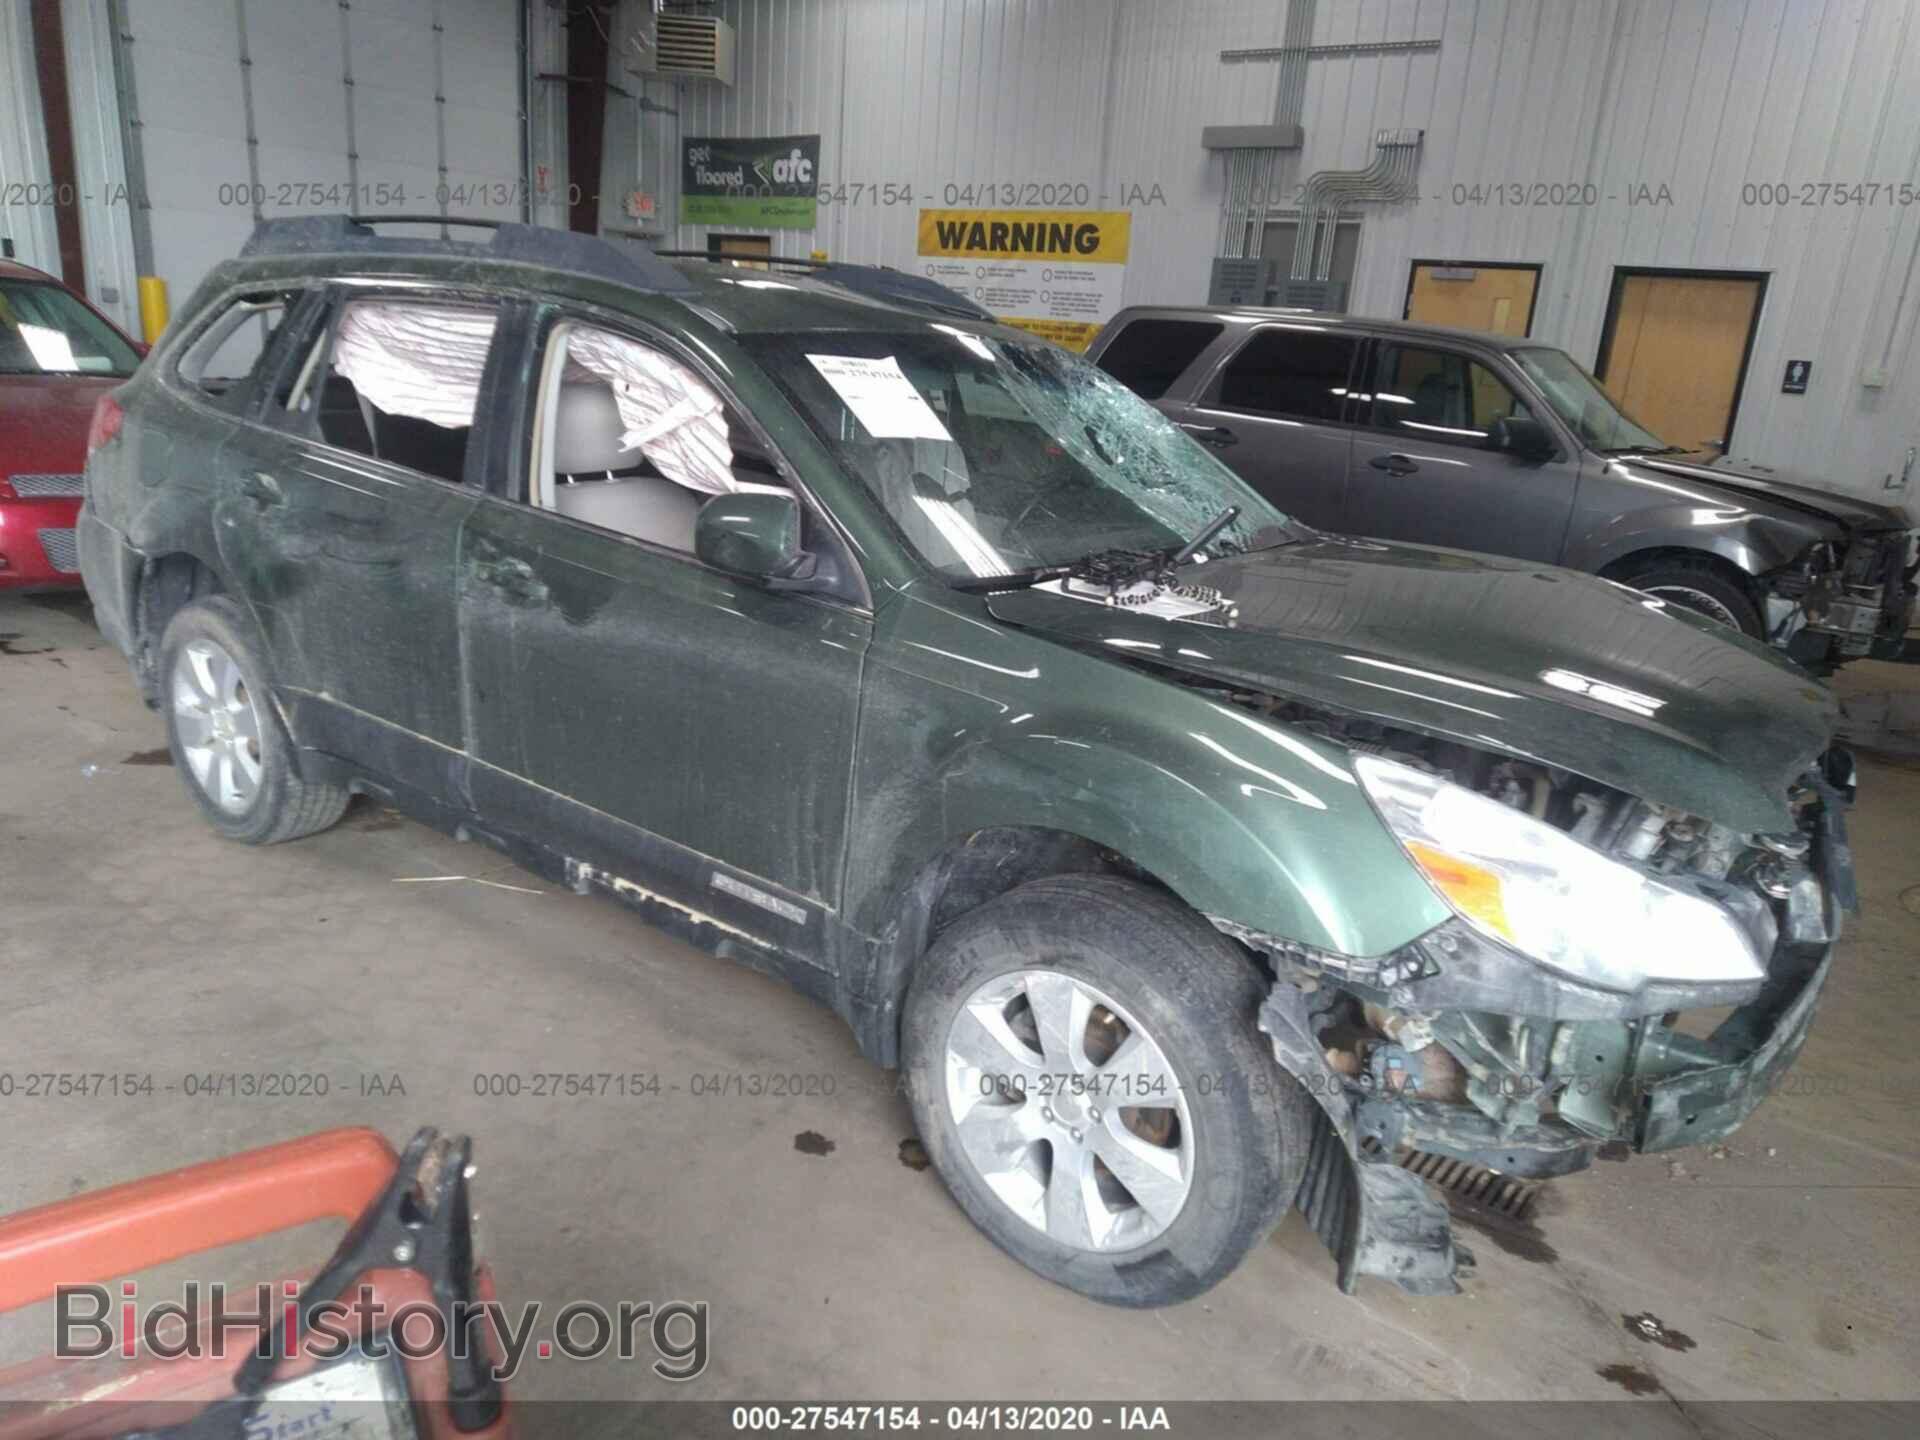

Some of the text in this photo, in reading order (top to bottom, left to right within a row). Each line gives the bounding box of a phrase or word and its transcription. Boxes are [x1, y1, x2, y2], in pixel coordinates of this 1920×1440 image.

[687, 146, 710, 167] get
[772, 148, 813, 183] afc
[696, 165, 744, 185] floored
[936, 220, 1101, 255] WARNING
